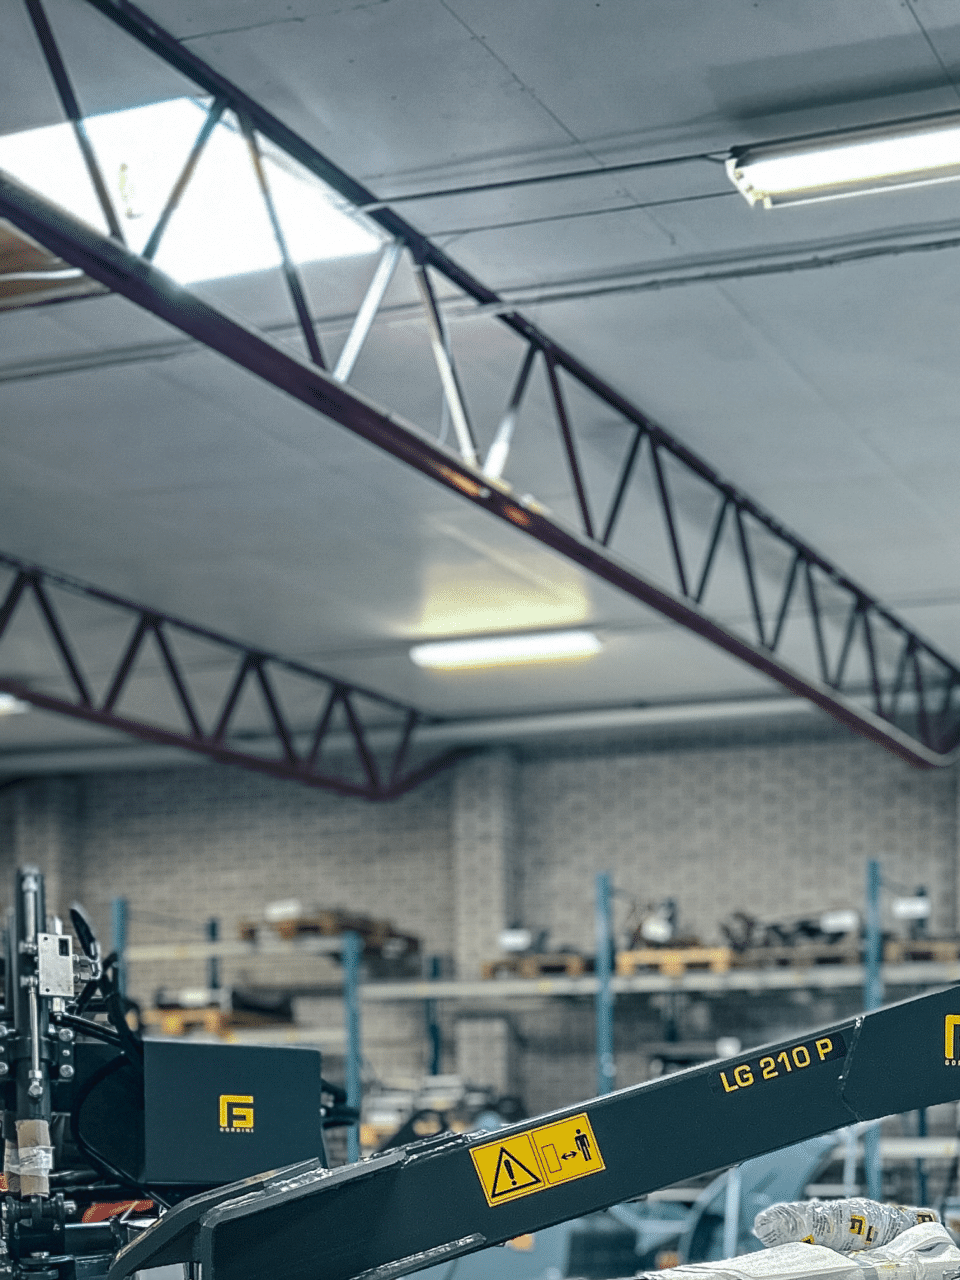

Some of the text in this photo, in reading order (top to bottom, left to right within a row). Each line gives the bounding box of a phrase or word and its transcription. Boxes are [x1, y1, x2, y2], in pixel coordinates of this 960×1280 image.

[720, 1037, 833, 1093] LG 210 P
